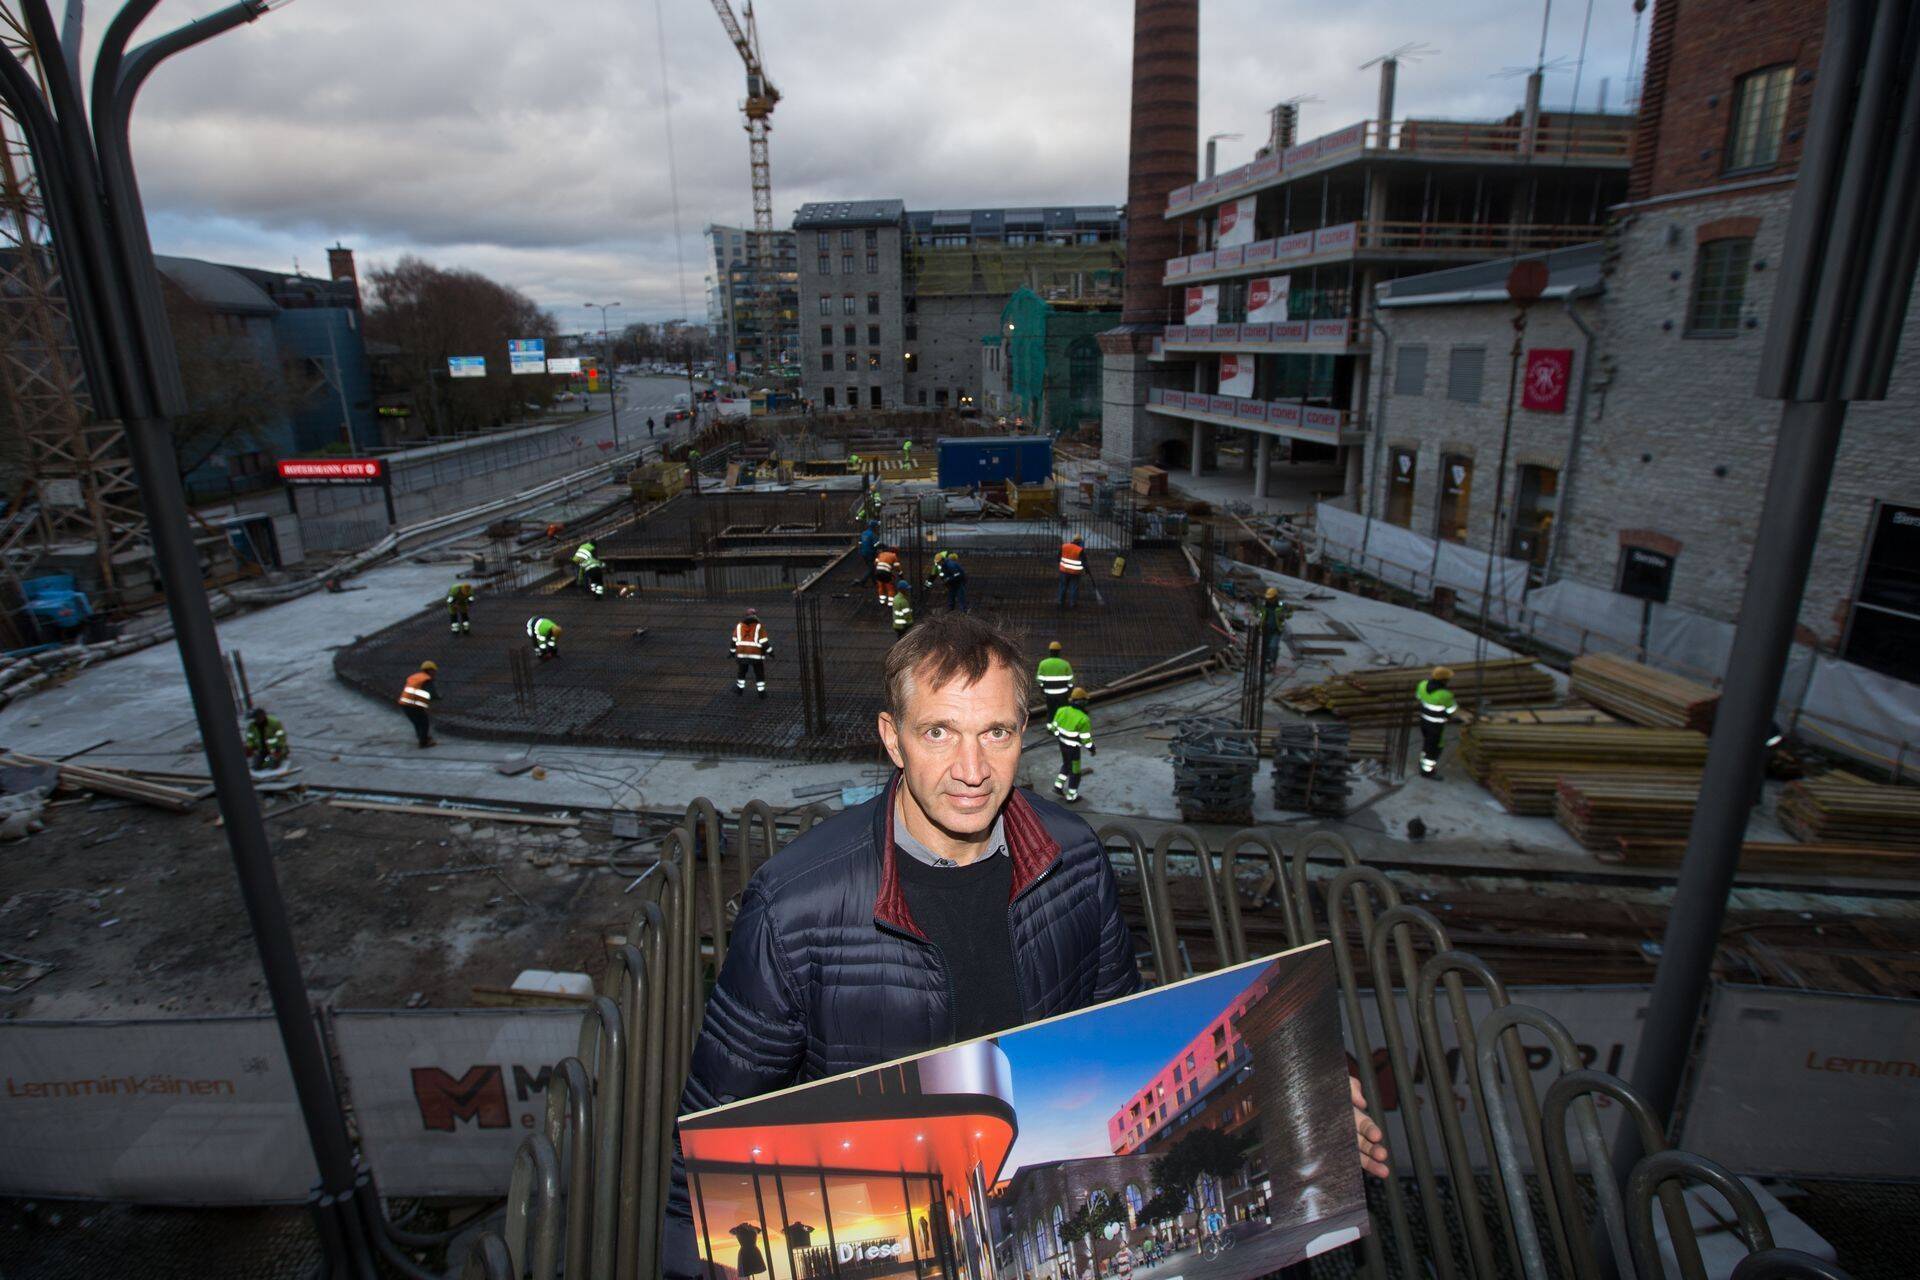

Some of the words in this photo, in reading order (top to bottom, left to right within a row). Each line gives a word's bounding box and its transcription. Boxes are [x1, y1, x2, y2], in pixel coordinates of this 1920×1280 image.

[1320, 230, 1350, 245] conex
[1244, 326, 1267, 337] conex
[1276, 325, 1301, 336] conex
[1313, 324, 1343, 336] conex
[1241, 402, 1262, 415] conex
[1272, 407, 1298, 419] conex
[1307, 411, 1336, 426] conex
[342, 464, 364, 475] CITY
[1806, 1050, 1920, 1078] Lemm
[7, 1075, 235, 1098] Lemminkäinen
[838, 1238, 911, 1265] Diesel
